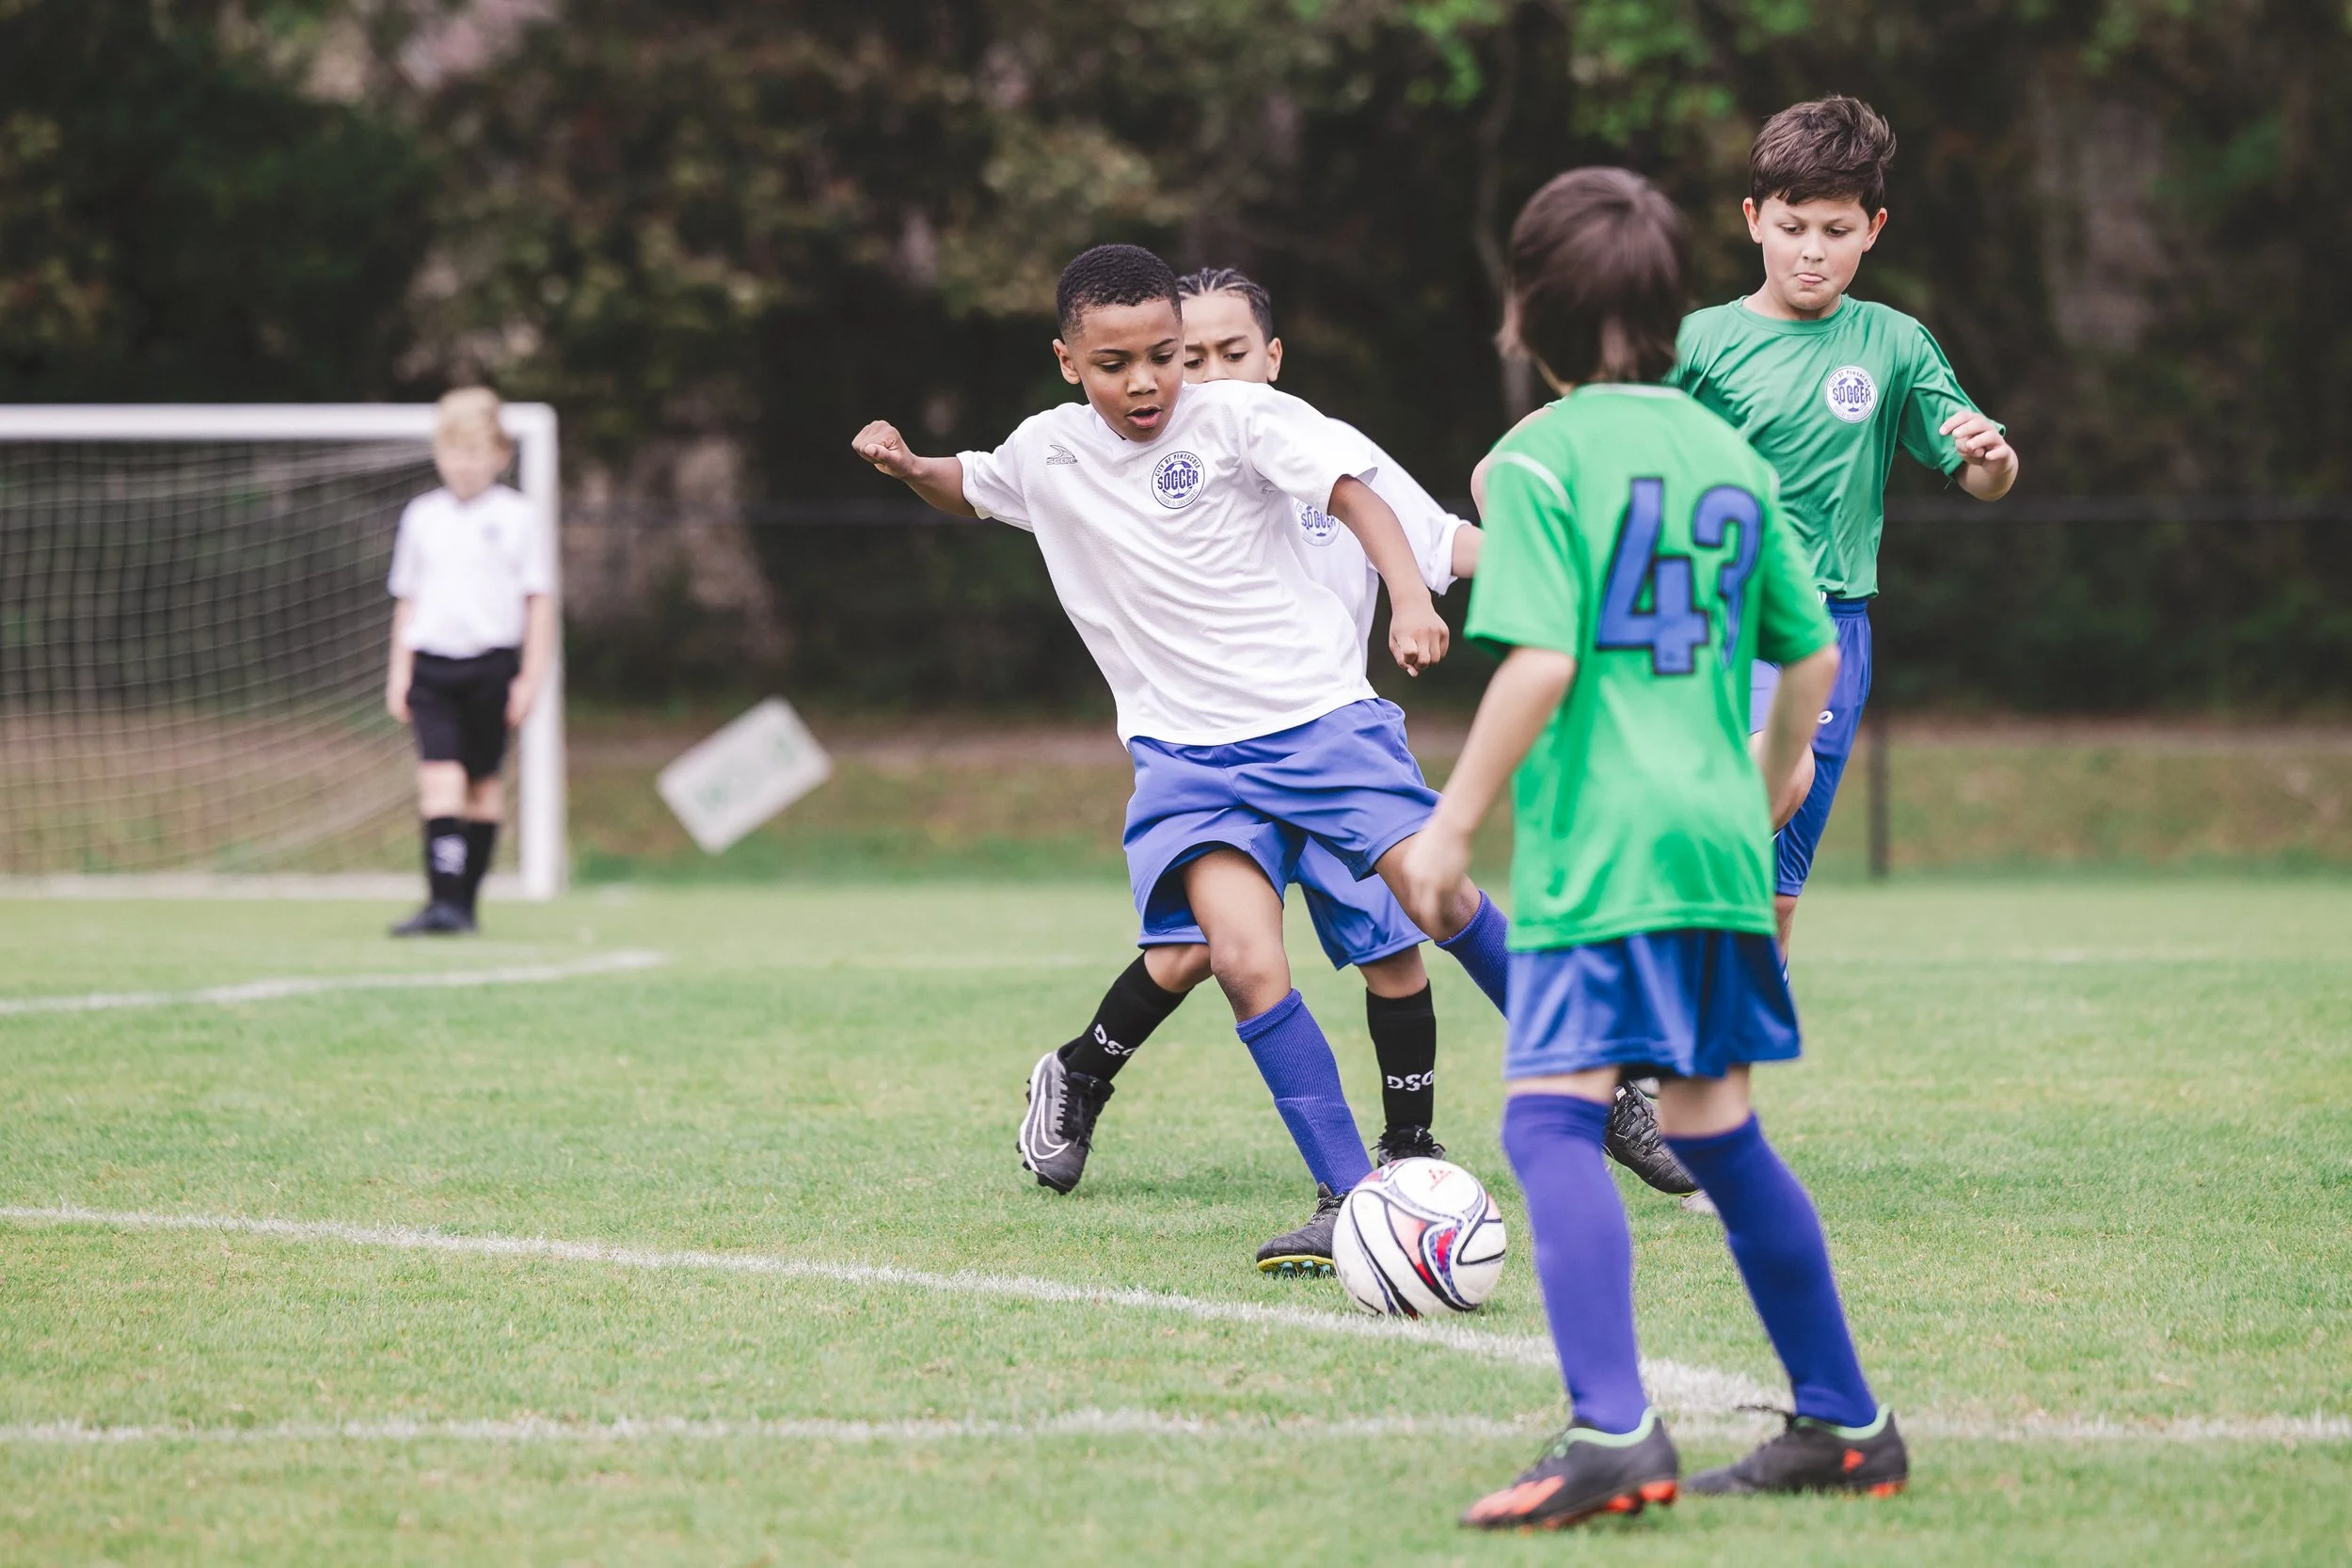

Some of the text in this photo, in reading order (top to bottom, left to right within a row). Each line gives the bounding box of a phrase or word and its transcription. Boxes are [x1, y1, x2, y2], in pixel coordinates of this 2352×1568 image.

[1832, 385, 1872, 404] SOCCER
[1157, 468, 1199, 490] SOCCER
[1595, 475, 1763, 675] 43
